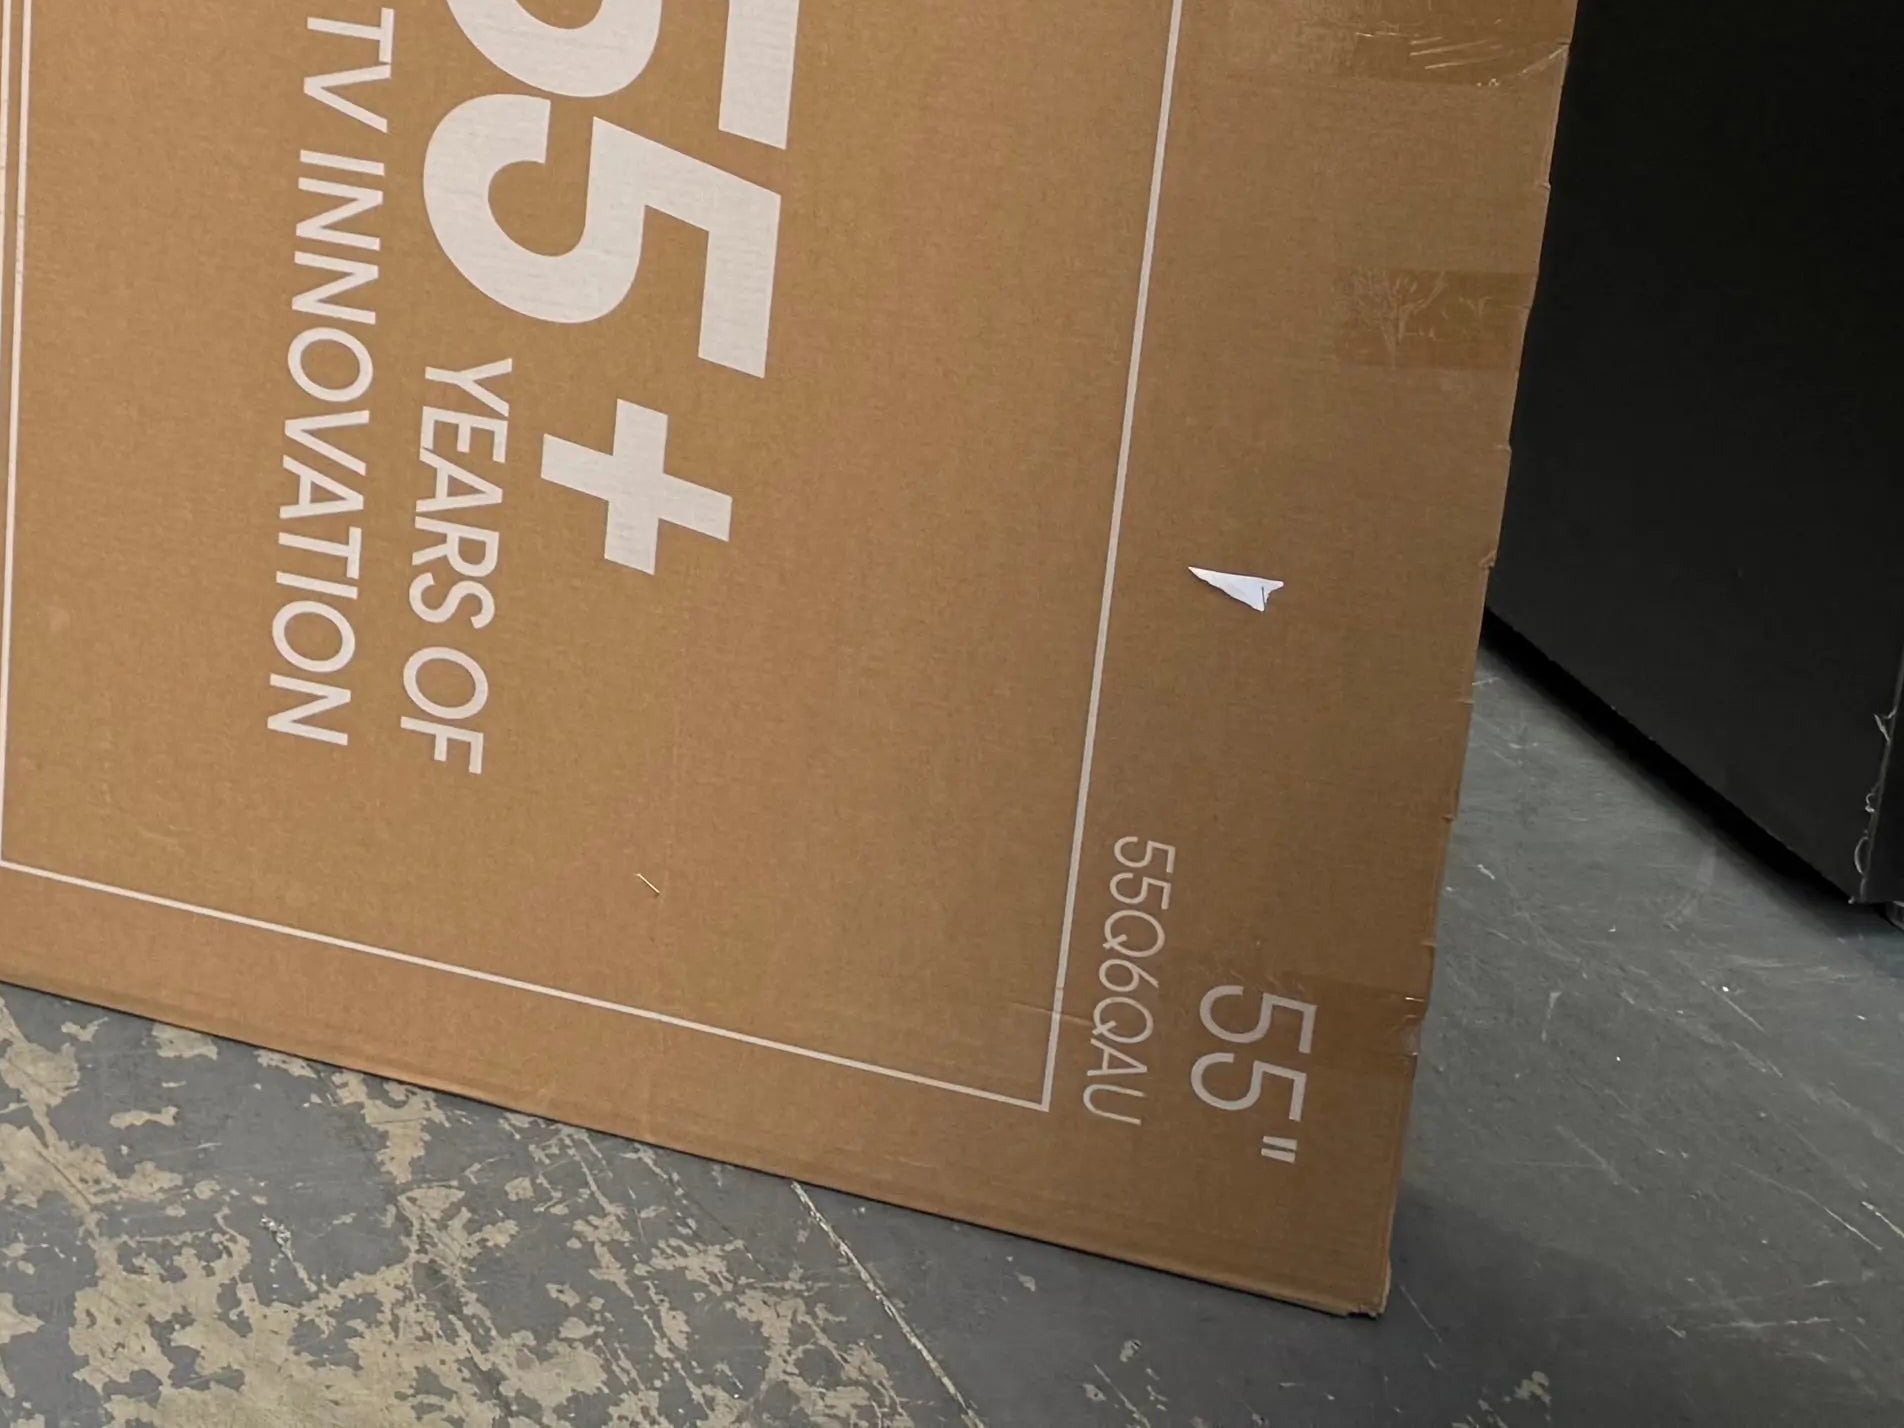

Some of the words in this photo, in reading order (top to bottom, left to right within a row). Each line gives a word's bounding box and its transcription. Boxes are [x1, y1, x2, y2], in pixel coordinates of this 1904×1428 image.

[304, 8, 394, 133] TV
[268, 150, 385, 745] INNOVATION
[409, 358, 512, 628] YEARS
[401, 647, 488, 774] OF
[1083, 836, 1175, 1124] 55Q6QAU
[1191, 985, 1317, 1163] 55"
